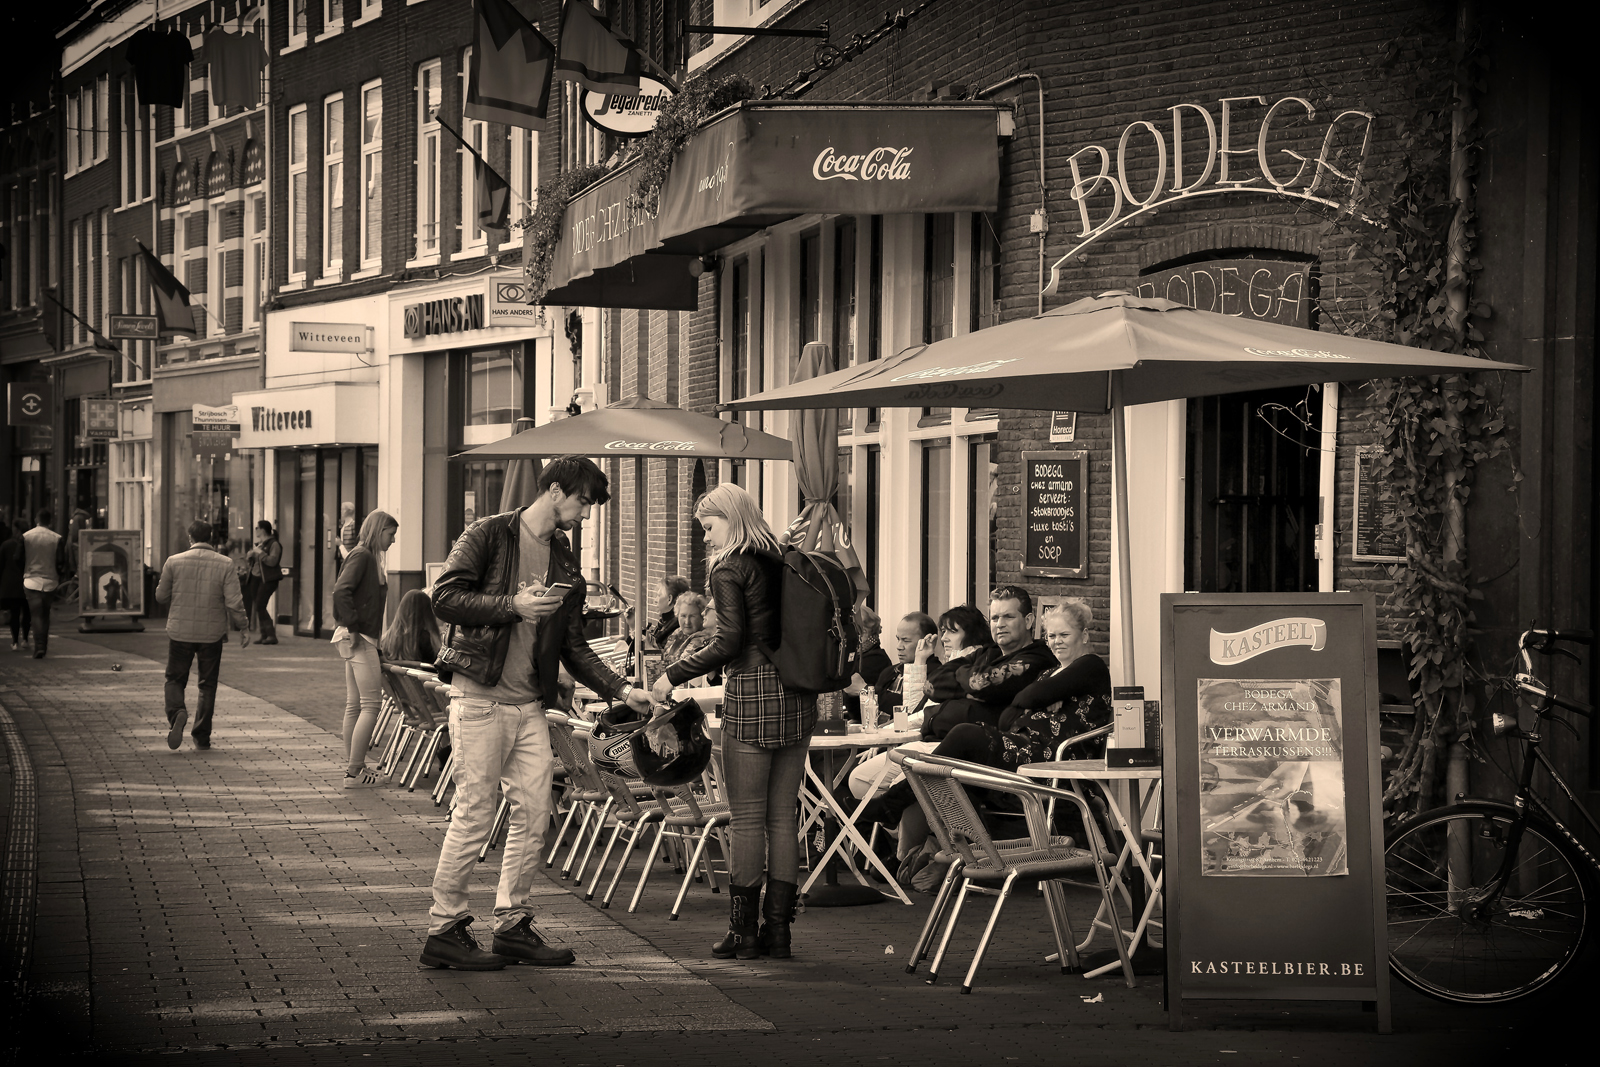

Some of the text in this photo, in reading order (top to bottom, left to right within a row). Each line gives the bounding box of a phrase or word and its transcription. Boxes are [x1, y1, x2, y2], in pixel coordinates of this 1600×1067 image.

[812, 146, 915, 182] Coca-Cola
[1066, 96, 1376, 238] BODEGA
[424, 297, 464, 336] HANS
[492, 309, 533, 318] HANS ANDERS
[299, 331, 361, 344] Witteveen
[251, 406, 312, 431] Witteveen
[1053, 426, 1072, 434] Horeca
[1044, 535, 1054, 544] en
[1222, 622, 1313, 658] KASTEEL
[1244, 689, 1293, 698] BODEGA
[1224, 702, 1315, 711] CHEZ ARMAND
[1210, 727, 1332, 742] VERWARMDE
[611, 742, 630, 756] SHOEI
[1213, 746, 1332, 757] TERRASKUSSENS!!!
[1191, 961, 1365, 976] KASTEELBIER.BE
